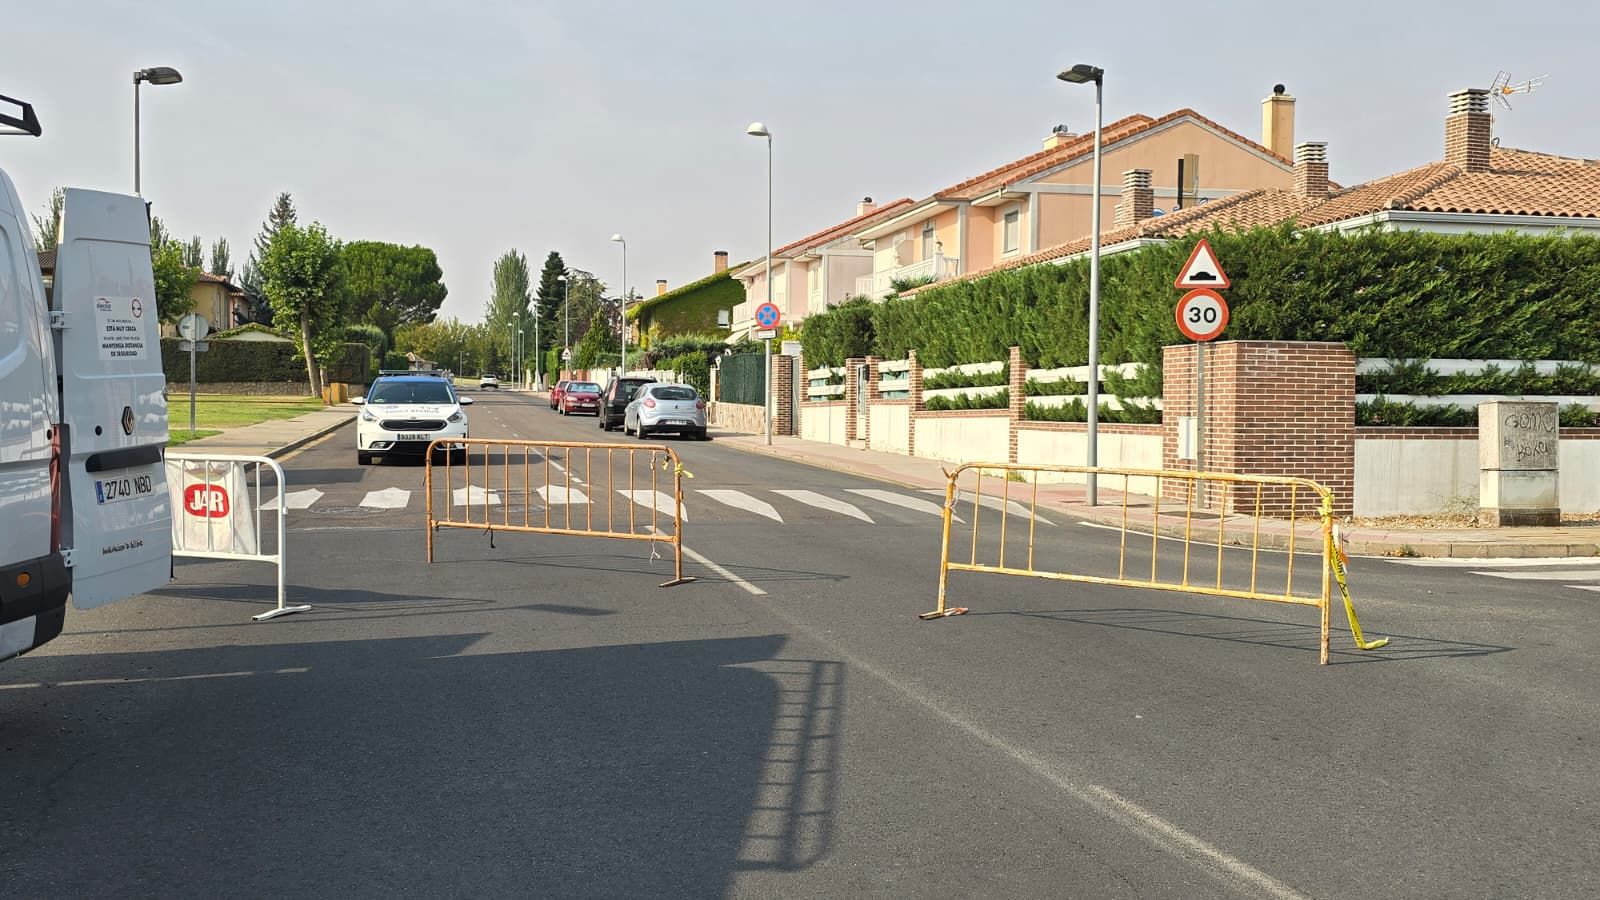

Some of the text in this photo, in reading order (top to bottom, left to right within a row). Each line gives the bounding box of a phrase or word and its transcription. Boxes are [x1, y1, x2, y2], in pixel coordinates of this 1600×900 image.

[1189, 307, 1217, 323] 30
[105, 475, 152, 500] 2740 NBD
